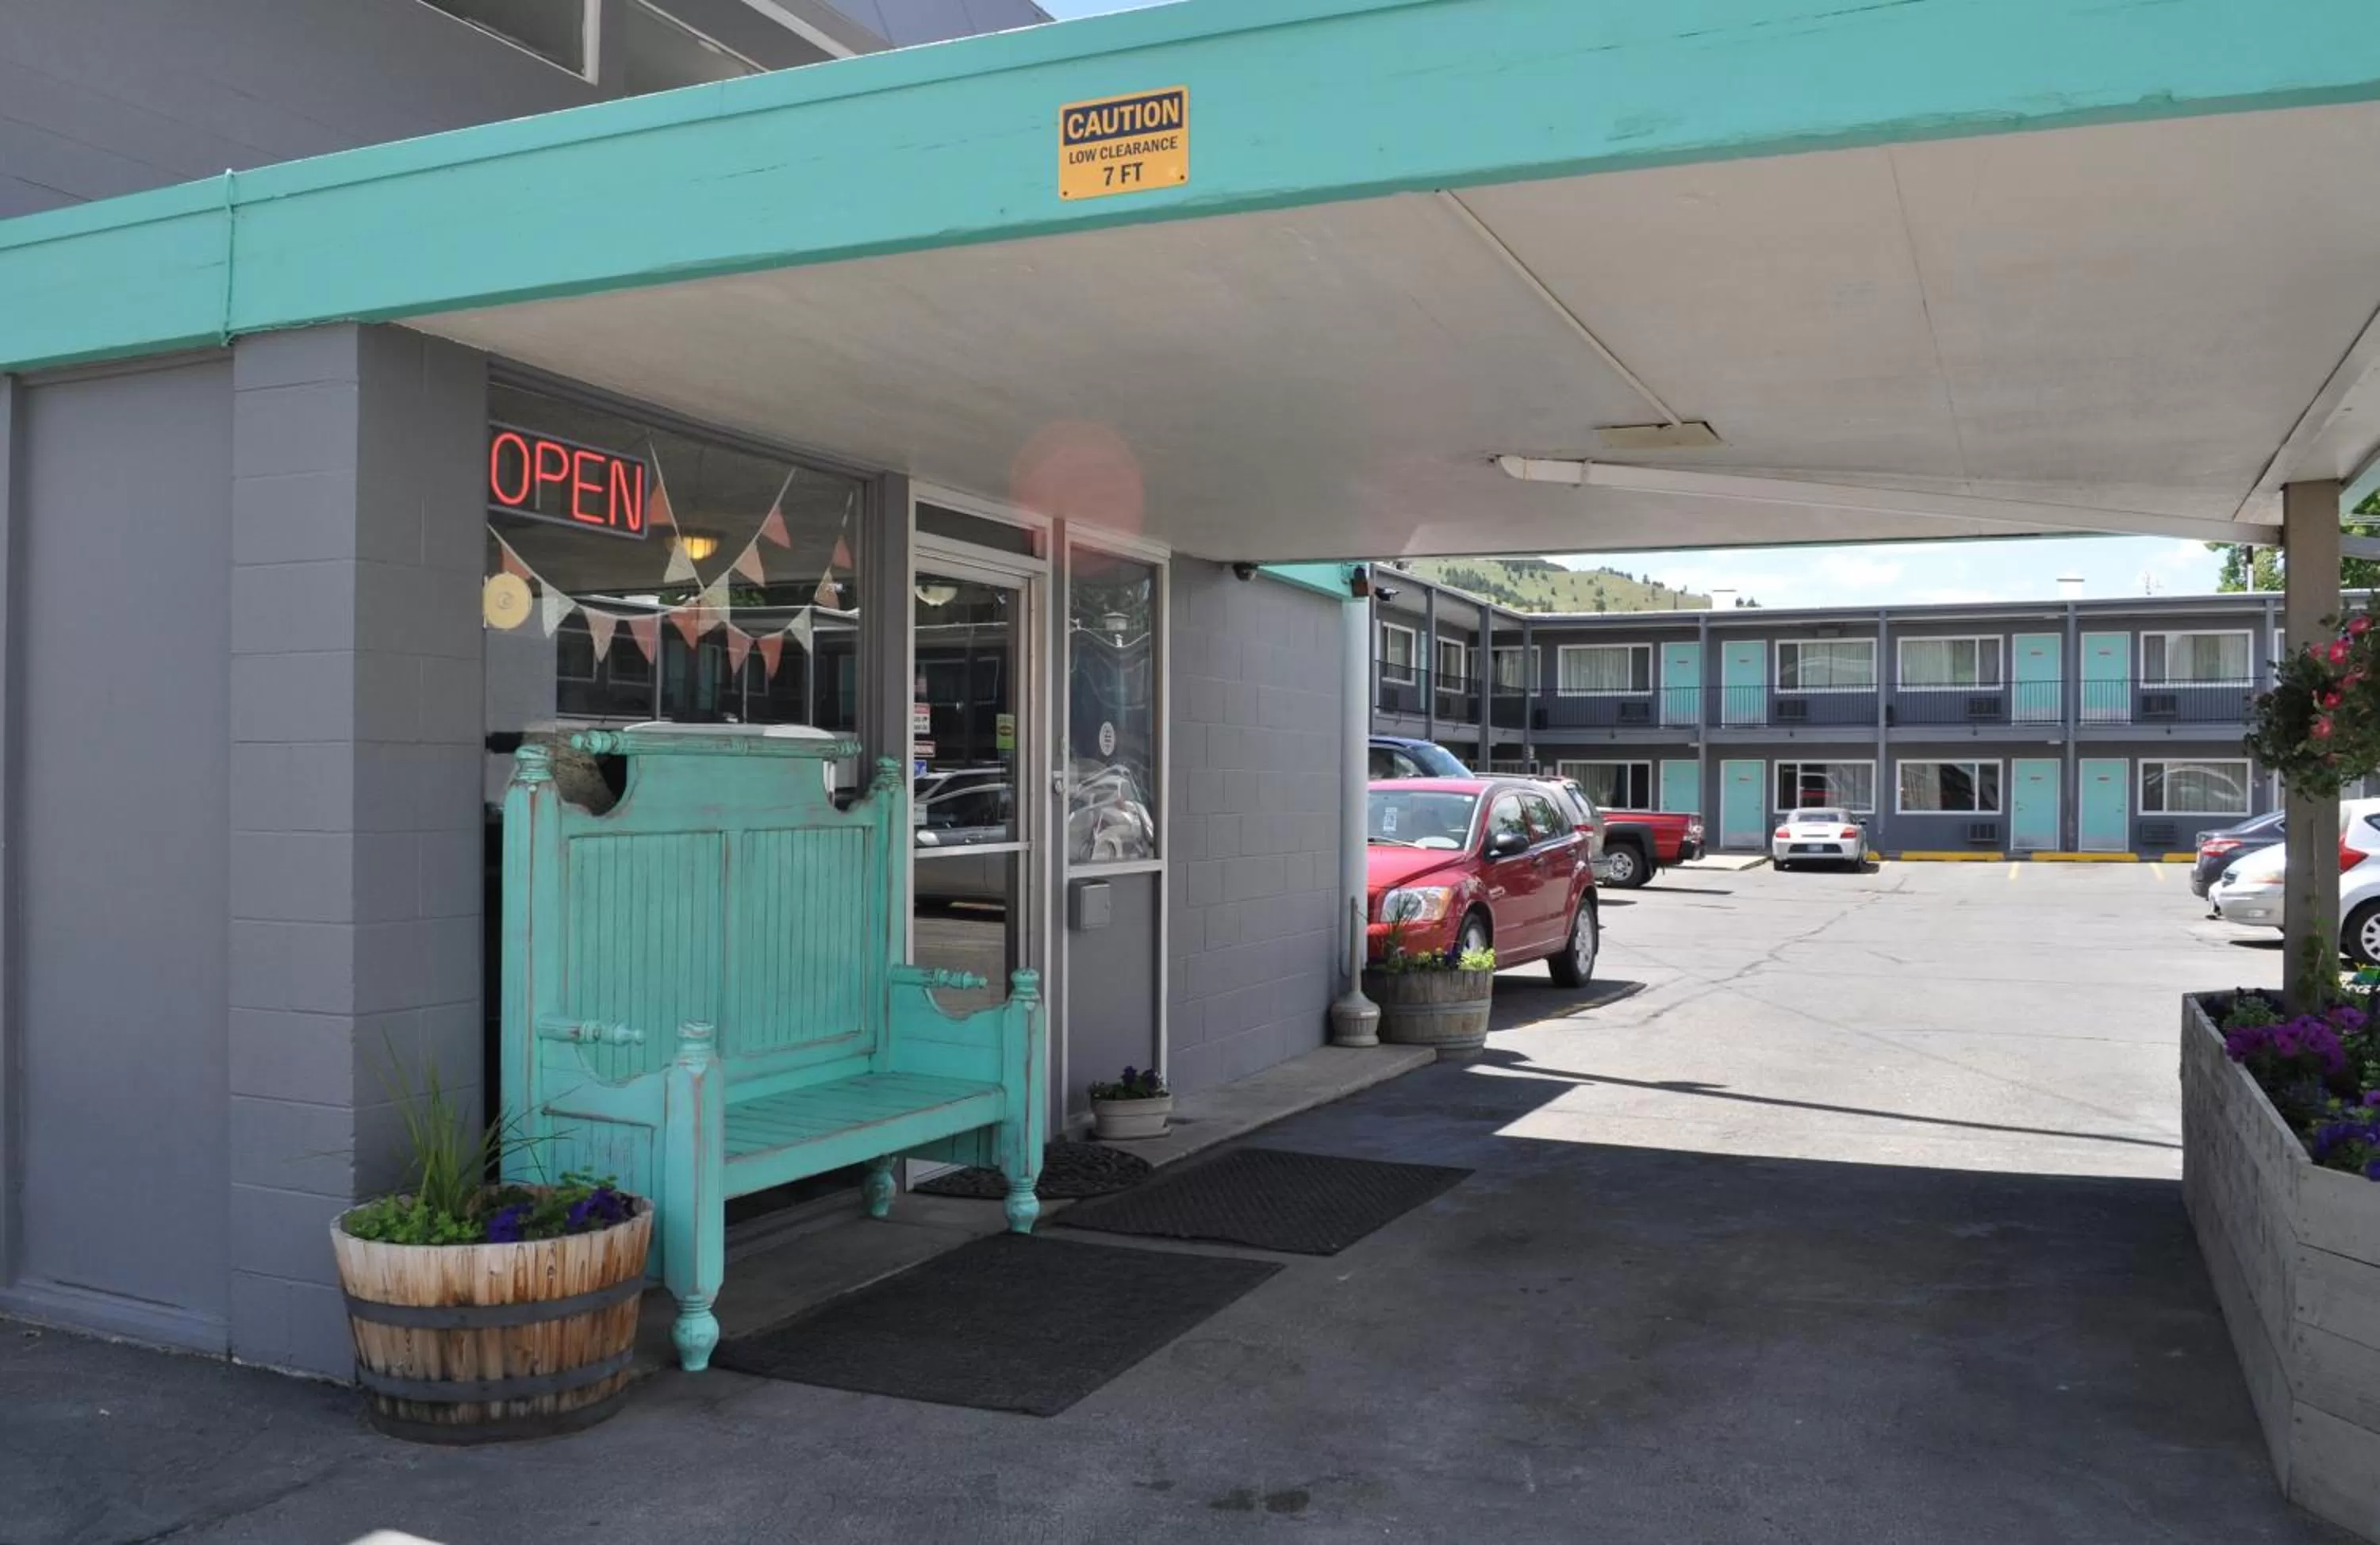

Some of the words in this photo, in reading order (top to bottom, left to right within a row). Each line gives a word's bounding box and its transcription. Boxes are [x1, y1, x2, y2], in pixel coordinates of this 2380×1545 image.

[1067, 98, 1179, 139] CAUTION
[1069, 148, 1097, 164] LOW
[1100, 136, 1178, 160] CLEARANCE
[1103, 166, 1114, 186] 7
[1121, 162, 1143, 184] FT
[490, 431, 643, 531] OPEN
